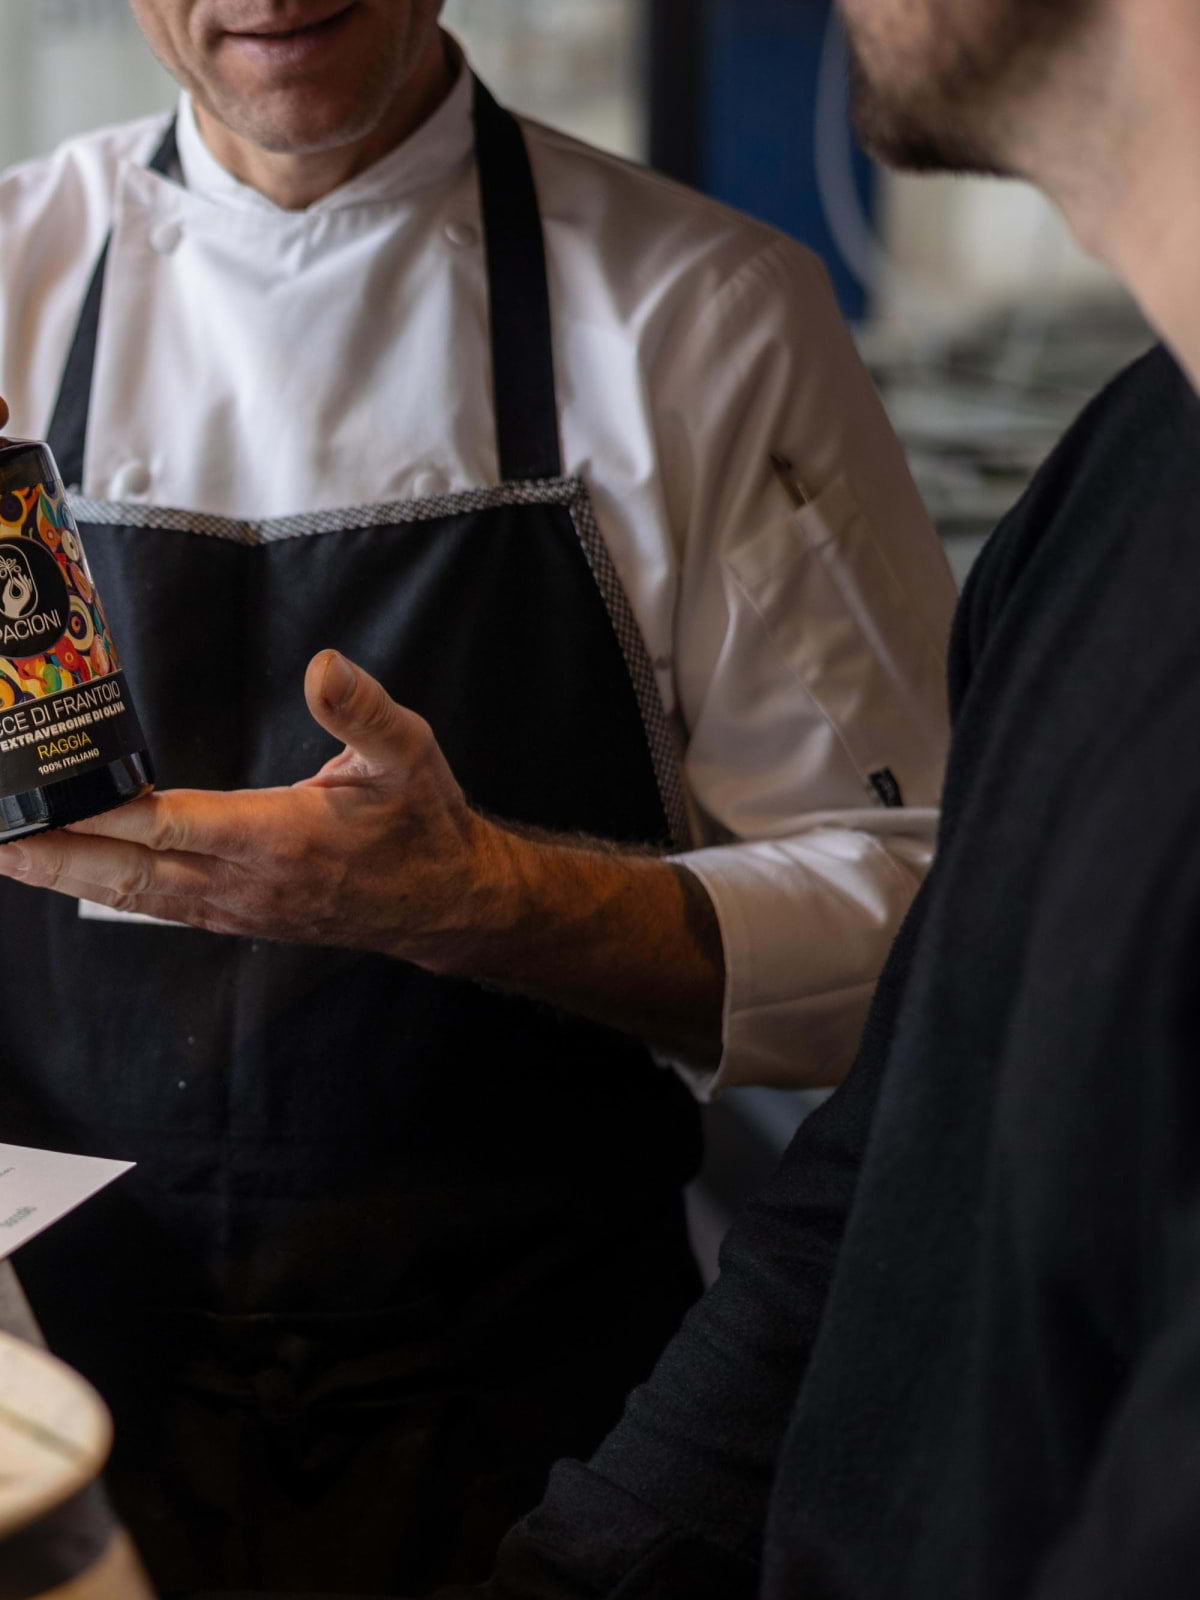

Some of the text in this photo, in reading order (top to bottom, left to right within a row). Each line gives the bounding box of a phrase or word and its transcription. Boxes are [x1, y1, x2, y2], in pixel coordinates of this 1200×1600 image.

[31, 704, 51, 726] DI
[52, 680, 120, 719] FRANTOIO
[0, 712, 93, 752] EXTRAVERGINE
[92, 708, 103, 722] DI
[103, 701, 125, 717] OLIVA
[37, 731, 92, 760] RAGGIA
[38, 748, 100, 775] 100% ITALIANO
